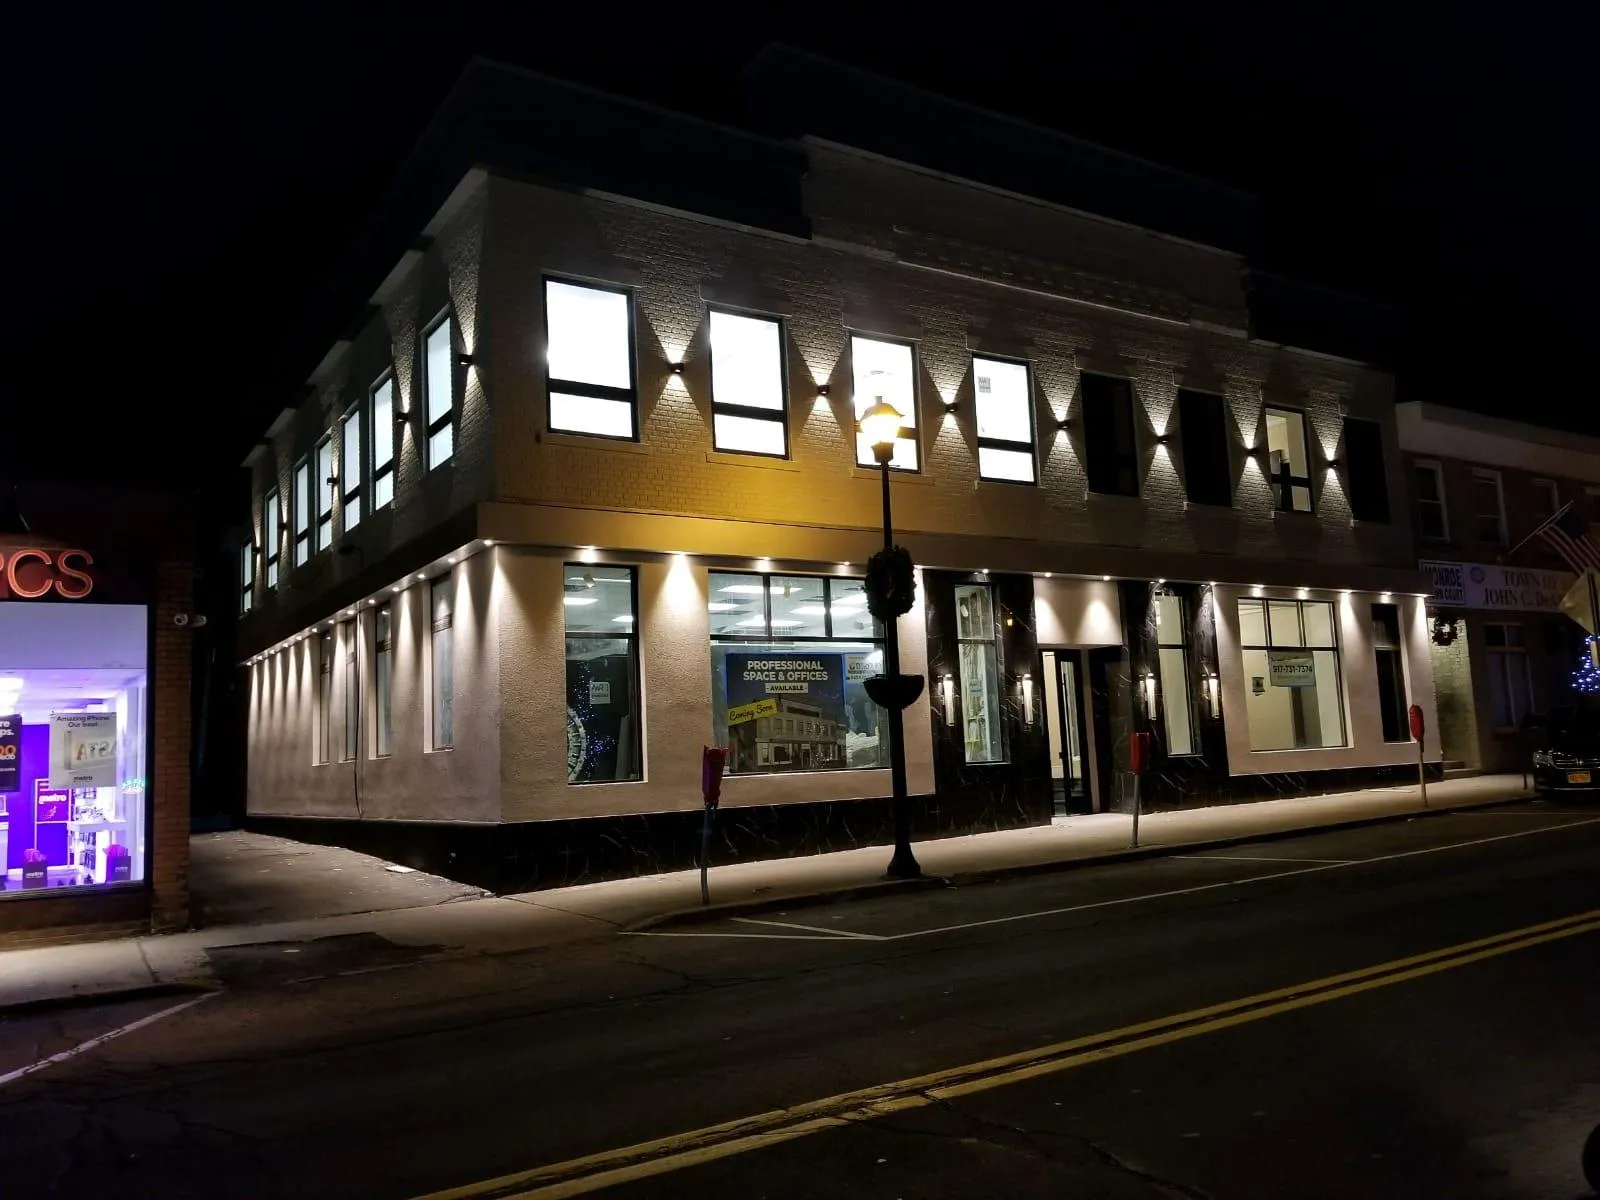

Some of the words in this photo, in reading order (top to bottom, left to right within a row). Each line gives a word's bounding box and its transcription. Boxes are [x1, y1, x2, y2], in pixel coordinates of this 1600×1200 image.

[0, 548, 94, 599] CS
[1484, 588, 1518, 606] JOHN
[747, 660, 823, 670] PROFESSIONAL
[743, 671, 776, 680] SPACE
[778, 671, 785, 680] &
[787, 671, 828, 681] OFFICES
[729, 708, 755, 721] Coming
